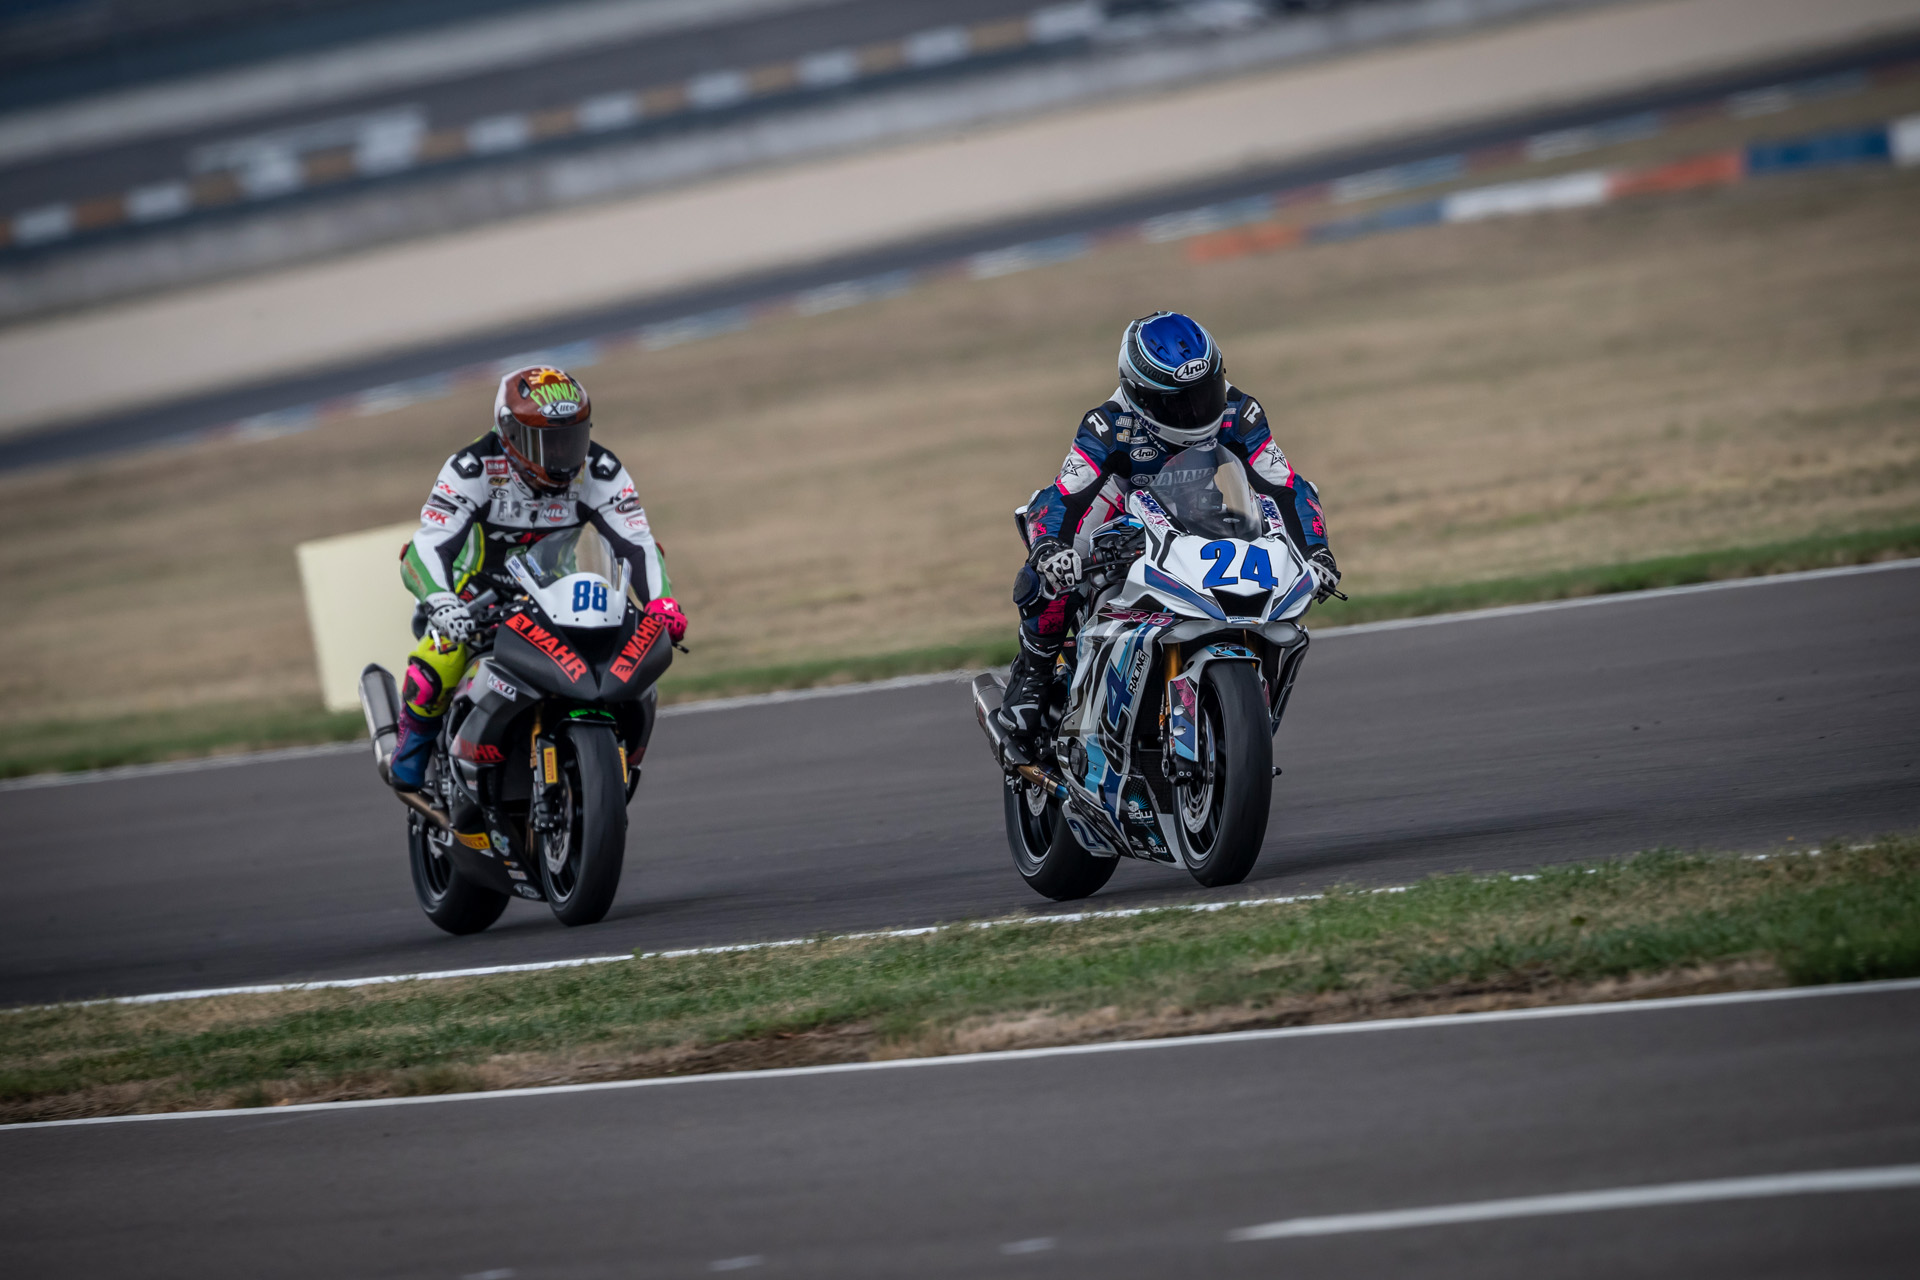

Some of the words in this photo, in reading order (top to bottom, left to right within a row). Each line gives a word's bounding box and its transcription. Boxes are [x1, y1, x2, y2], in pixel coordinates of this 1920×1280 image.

[1180, 360, 1206, 378] Arai
[530, 382, 581, 406] FYNNUS
[1136, 449, 1155, 459] Arai
[1151, 467, 1215, 486] YAMAHA
[541, 508, 569, 518] NILS
[1200, 540, 1279, 590] 24
[572, 580, 608, 613] 88
[621, 615, 659, 660] WAHR
[527, 624, 588, 681] WAHR
[1126, 650, 1150, 695] RACING
